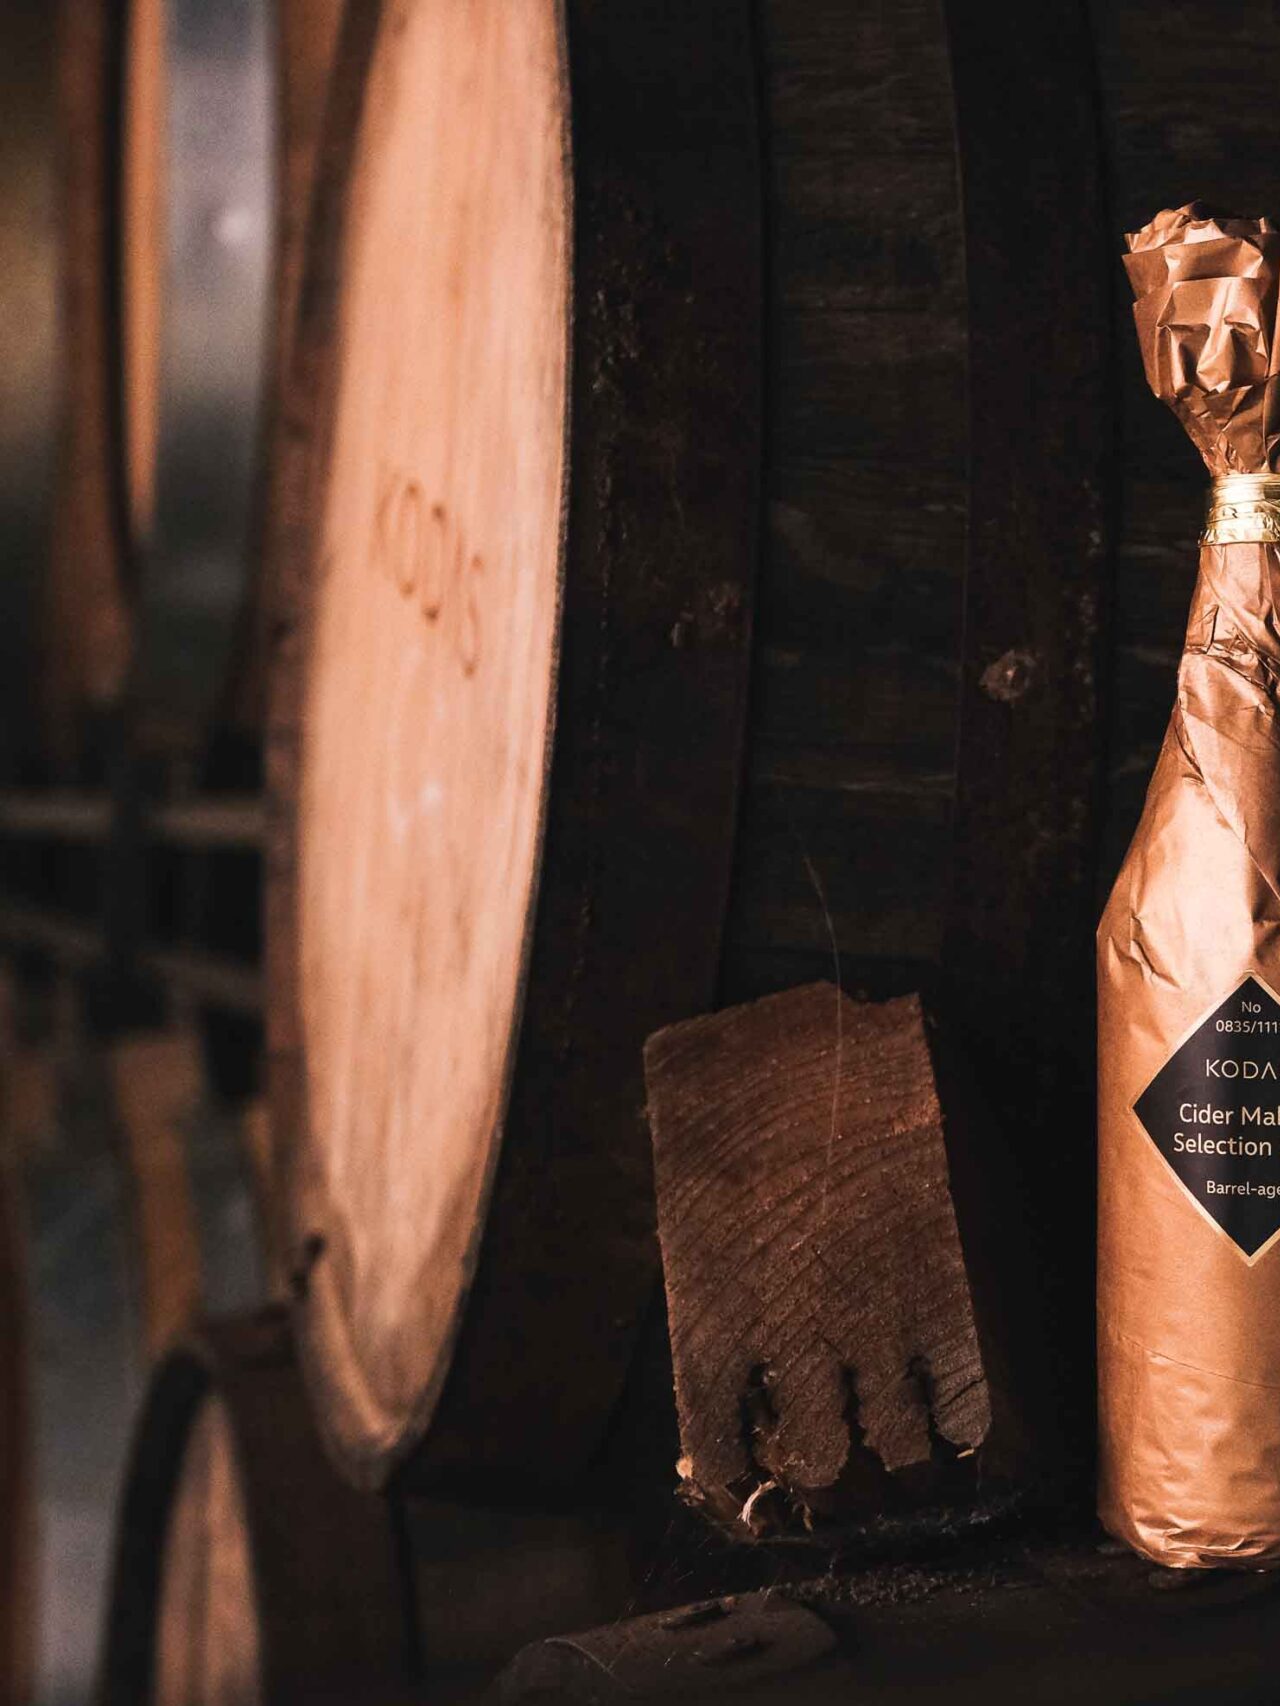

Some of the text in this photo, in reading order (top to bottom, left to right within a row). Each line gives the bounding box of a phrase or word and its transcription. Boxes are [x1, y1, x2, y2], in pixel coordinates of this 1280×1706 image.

[1242, 1002, 1262, 1013] No
[1180, 1103, 1234, 1125] Cider
[1174, 1133, 1271, 1156] Selection
